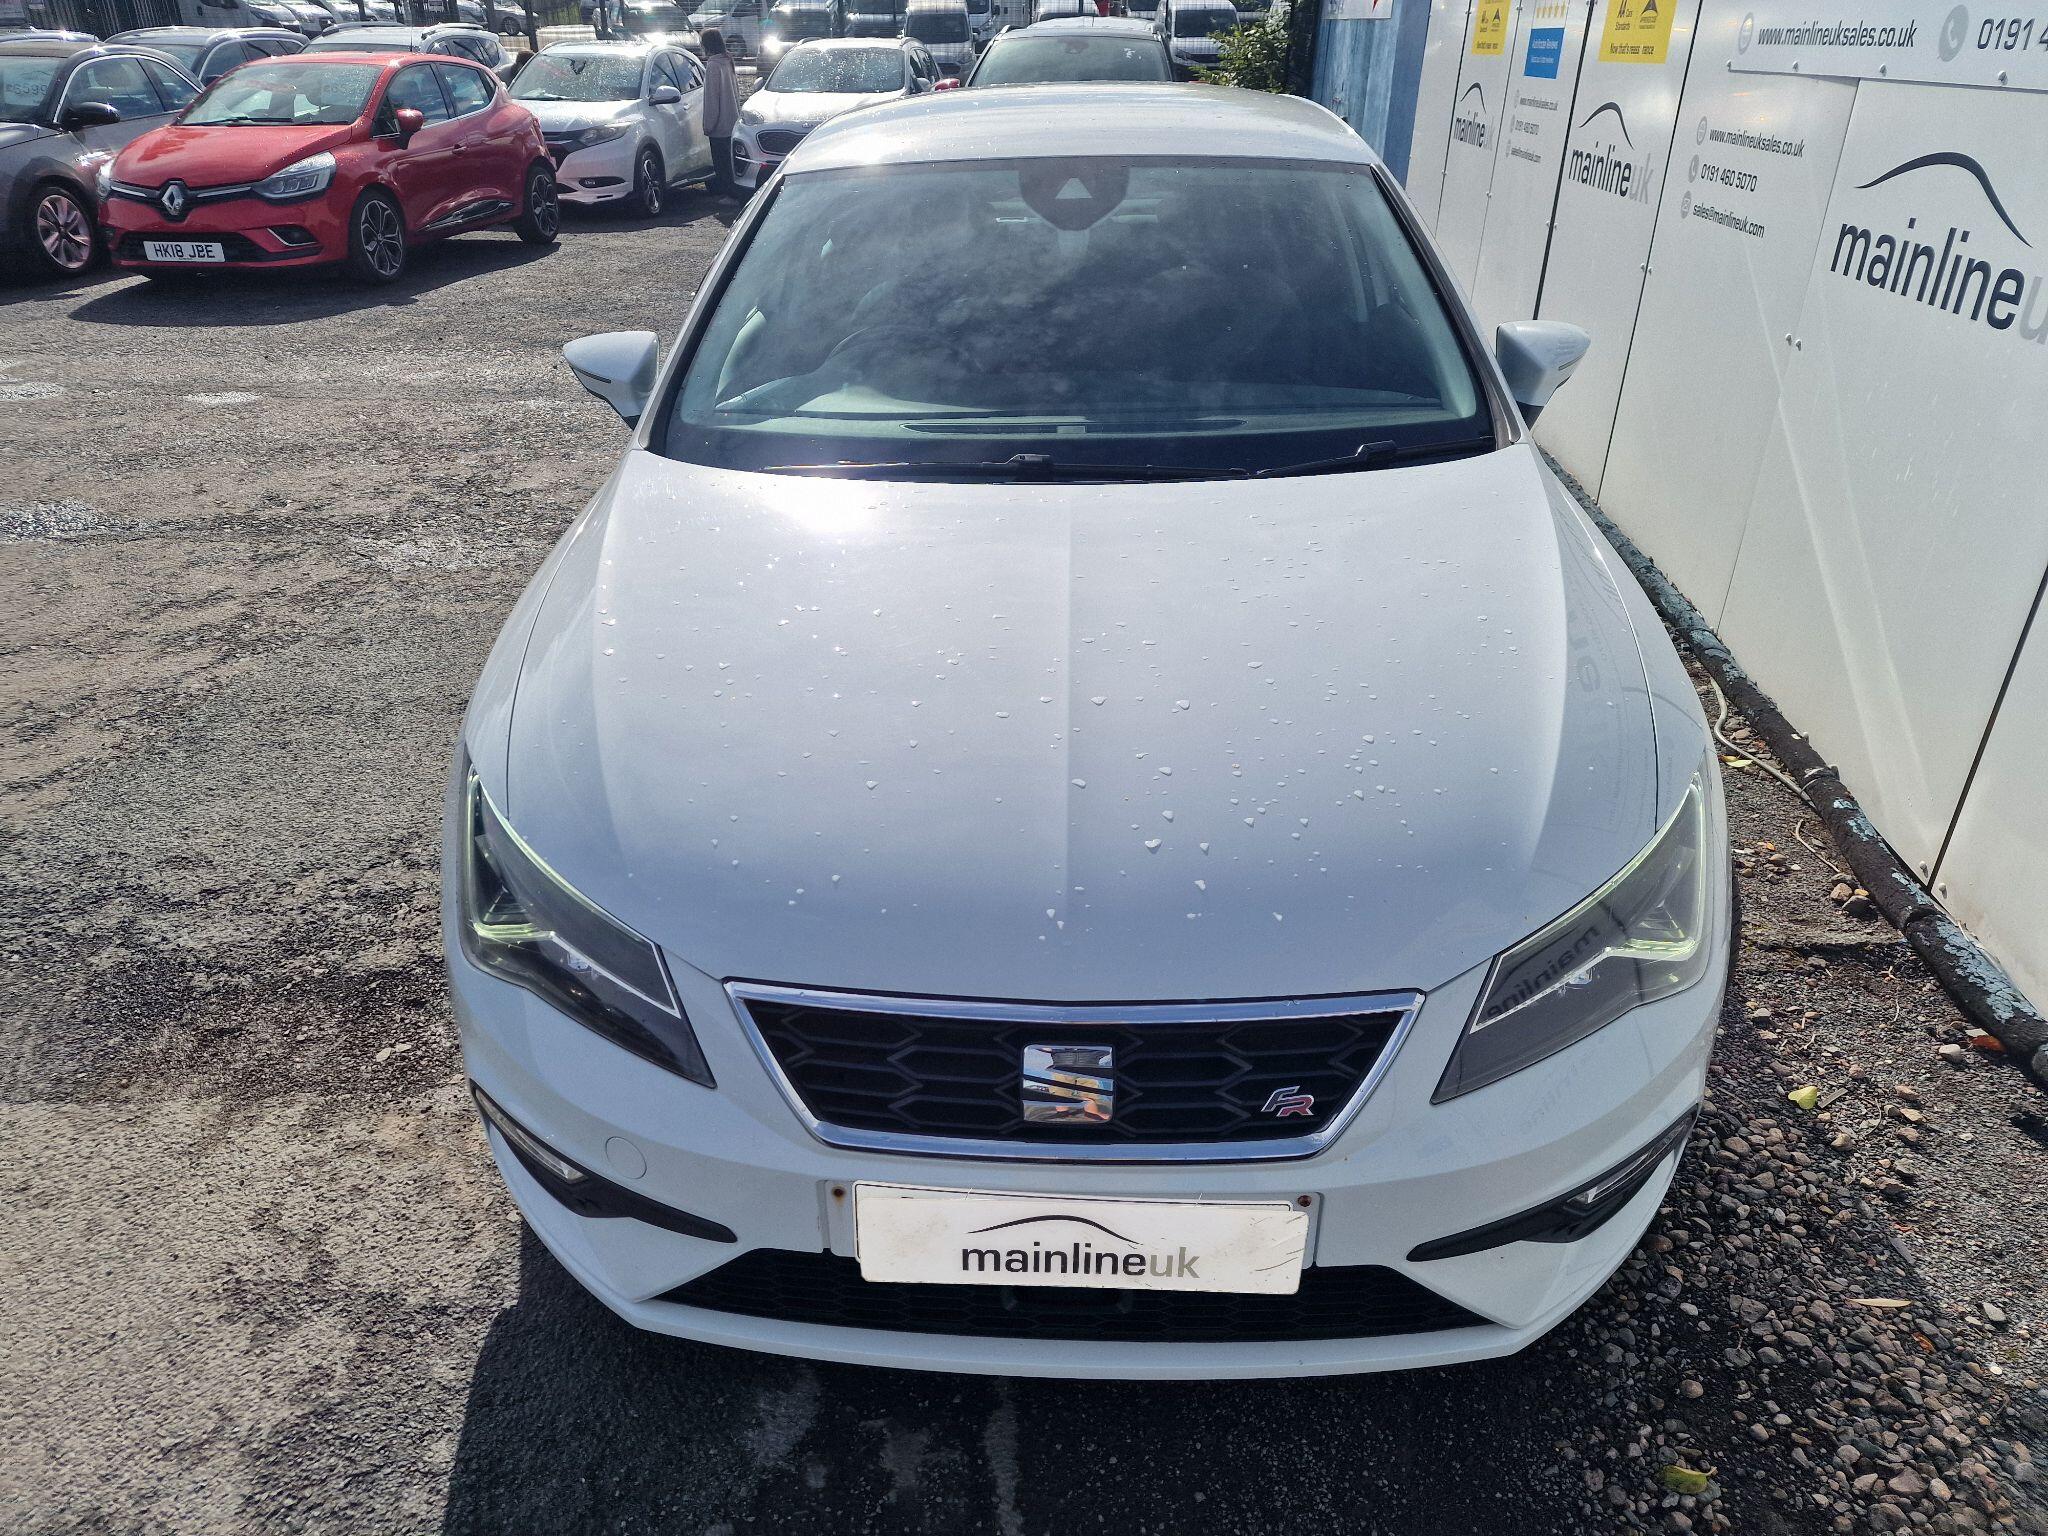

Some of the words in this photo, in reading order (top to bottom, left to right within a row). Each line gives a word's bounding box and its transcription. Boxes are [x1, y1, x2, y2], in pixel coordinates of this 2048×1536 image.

[1758, 19, 1917, 48] www.mainlineuksales.co.uk
[1977, 18, 2035, 50] 0191
[1709, 129, 1804, 157] www.mainlineuksales.co.uk
[1569, 141, 1654, 204] mainlineuk
[1701, 163, 1719, 182] 0191
[1720, 168, 1735, 187] 460
[1736, 172, 1757, 192] 5070
[1692, 202, 1765, 238] sales@mainlineuk.com
[153, 243, 184, 257] HK18
[189, 244, 215, 258] JBE
[962, 1241, 1200, 1279] mainlineuk
